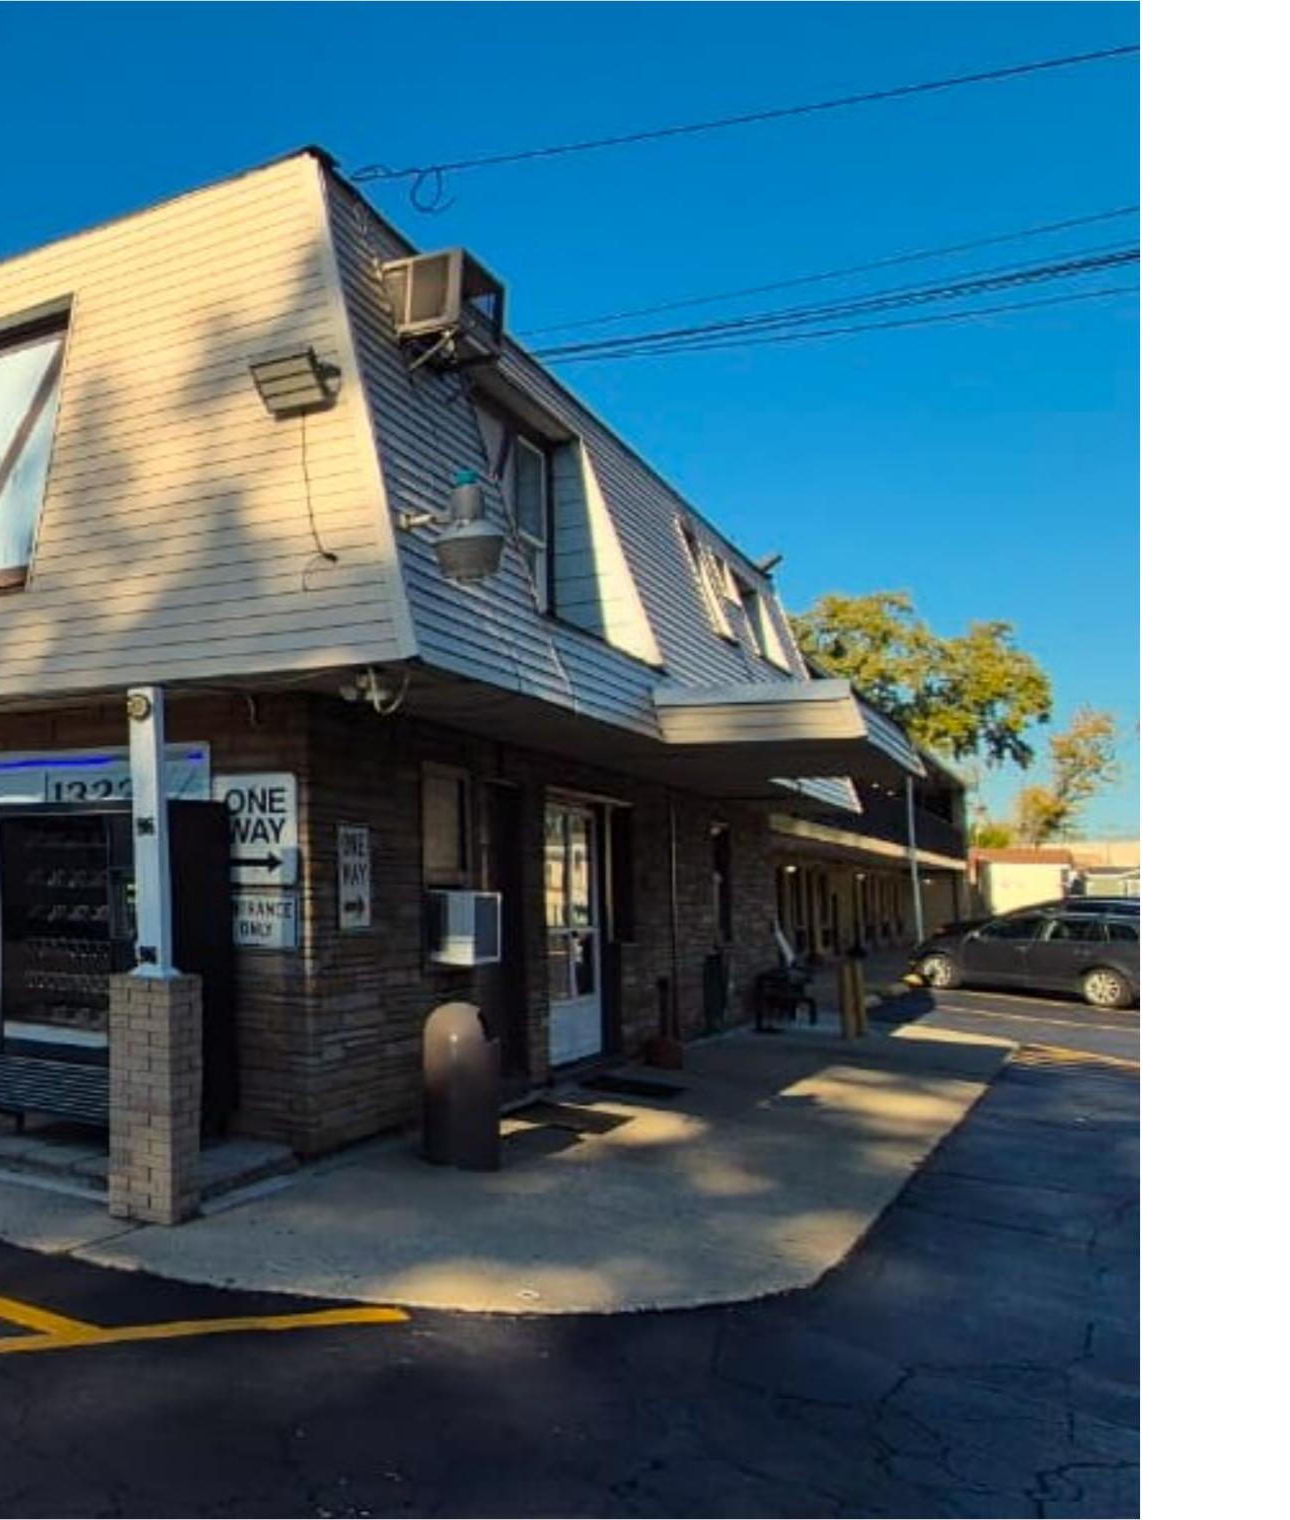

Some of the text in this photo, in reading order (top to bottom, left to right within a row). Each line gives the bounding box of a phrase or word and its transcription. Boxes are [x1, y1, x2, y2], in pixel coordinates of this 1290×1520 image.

[226, 788, 287, 815] ONE
[230, 818, 286, 844] WAY
[343, 832, 365, 857] ONE
[343, 863, 367, 886] WAY
[233, 902, 293, 918] NTRANCE
[240, 921, 273, 937] ONLY
